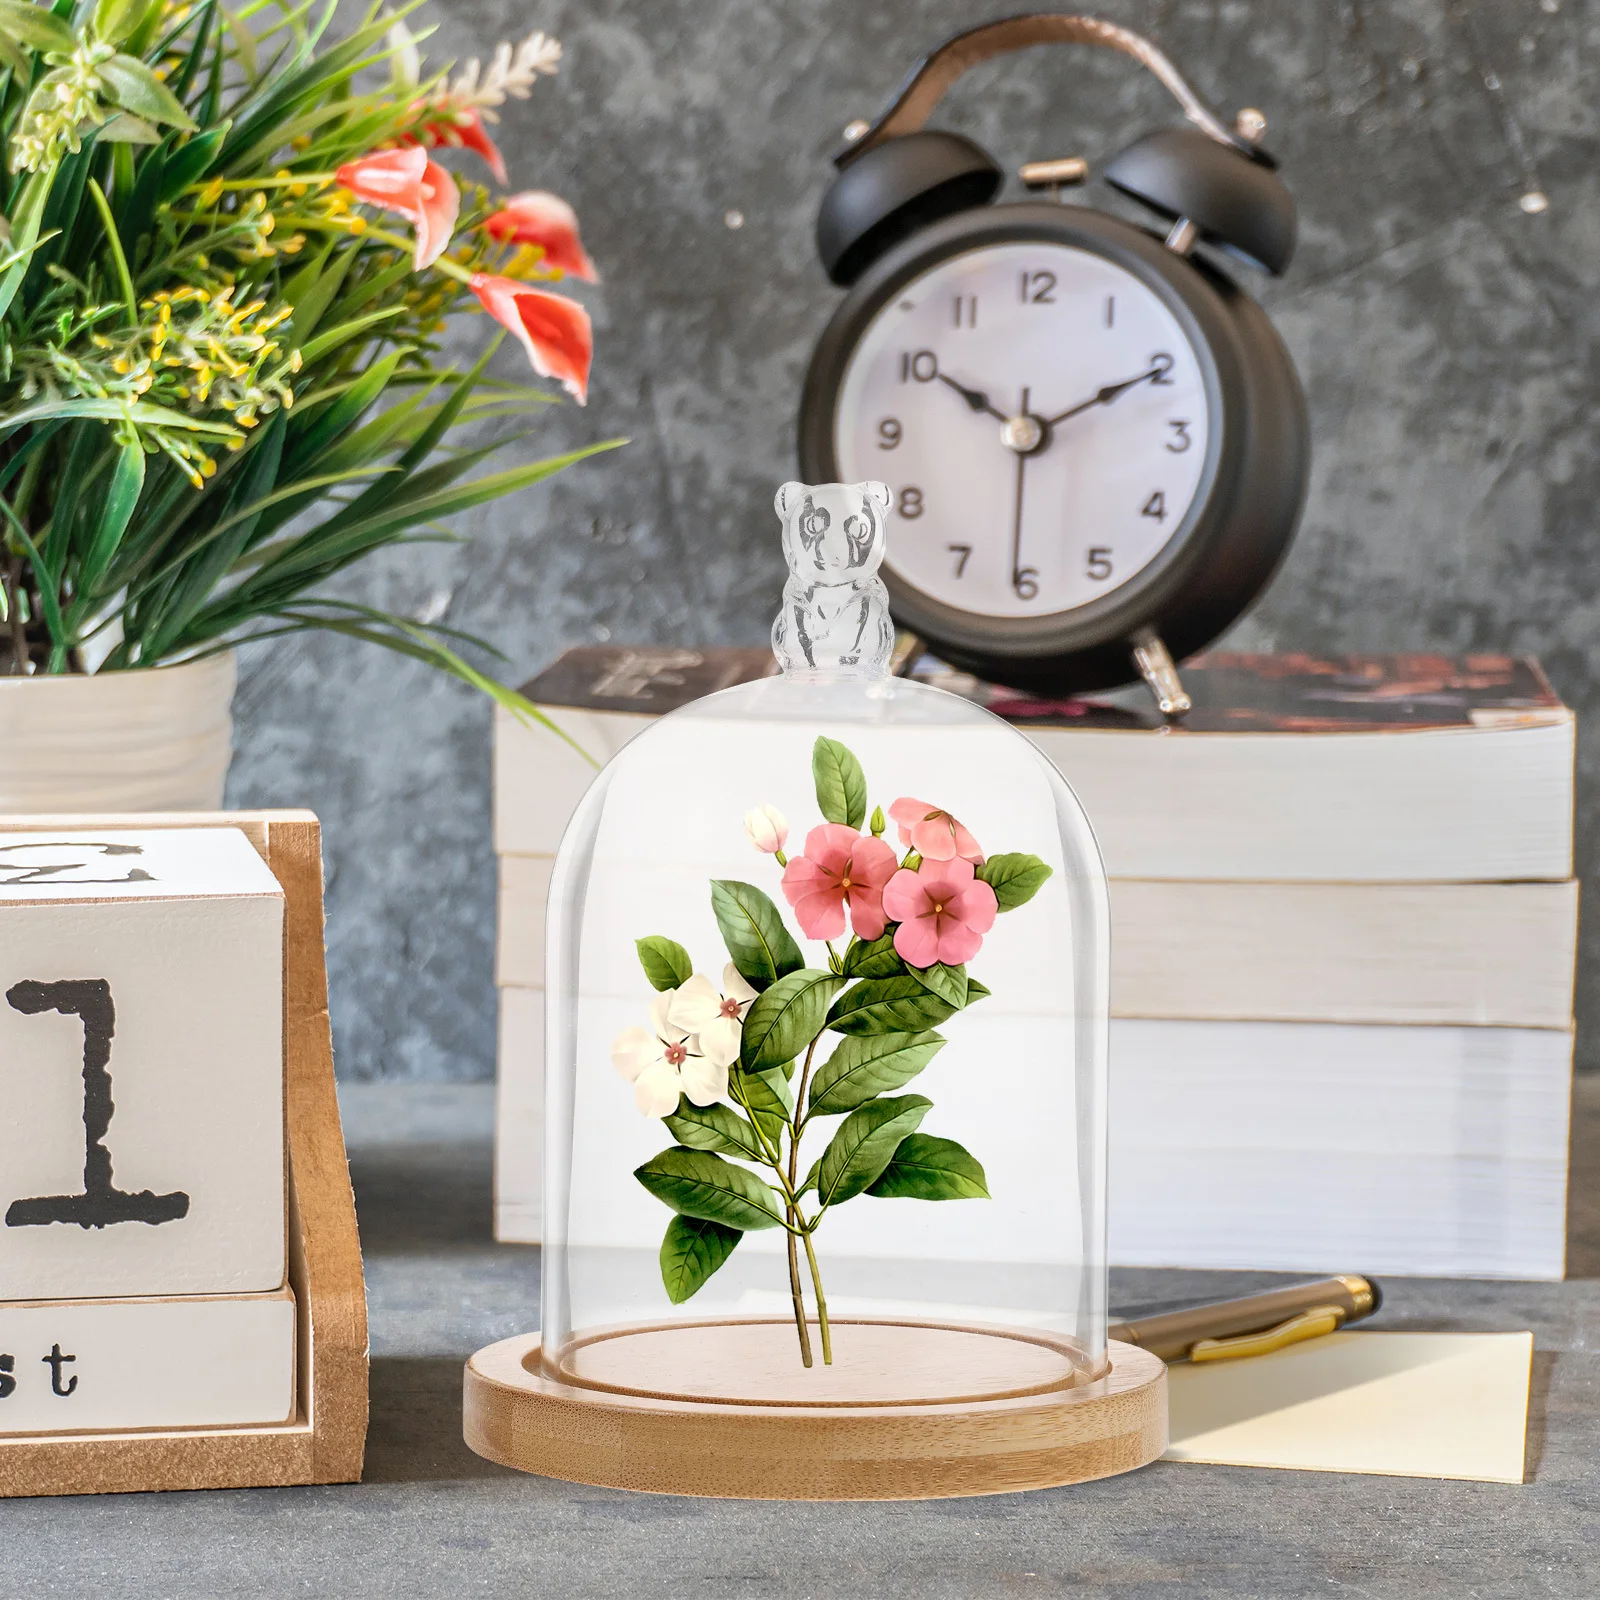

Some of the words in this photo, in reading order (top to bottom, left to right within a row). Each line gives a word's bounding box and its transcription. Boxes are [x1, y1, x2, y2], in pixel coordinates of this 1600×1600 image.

[1020, 271, 1057, 304] 12
[953, 296, 978, 329] 11
[1104, 296, 1116, 329] 1
[901, 350, 938, 384] 10
[1148, 352, 1175, 385] 2
[877, 418, 902, 450] 9
[1165, 420, 1192, 453] 3
[898, 487, 924, 520] 8
[1140, 491, 1168, 524] 4
[947, 545, 973, 579] 7
[1086, 548, 1113, 581] 5
[1013, 568, 1039, 601] 6
[5, 978, 190, 1229] 1
